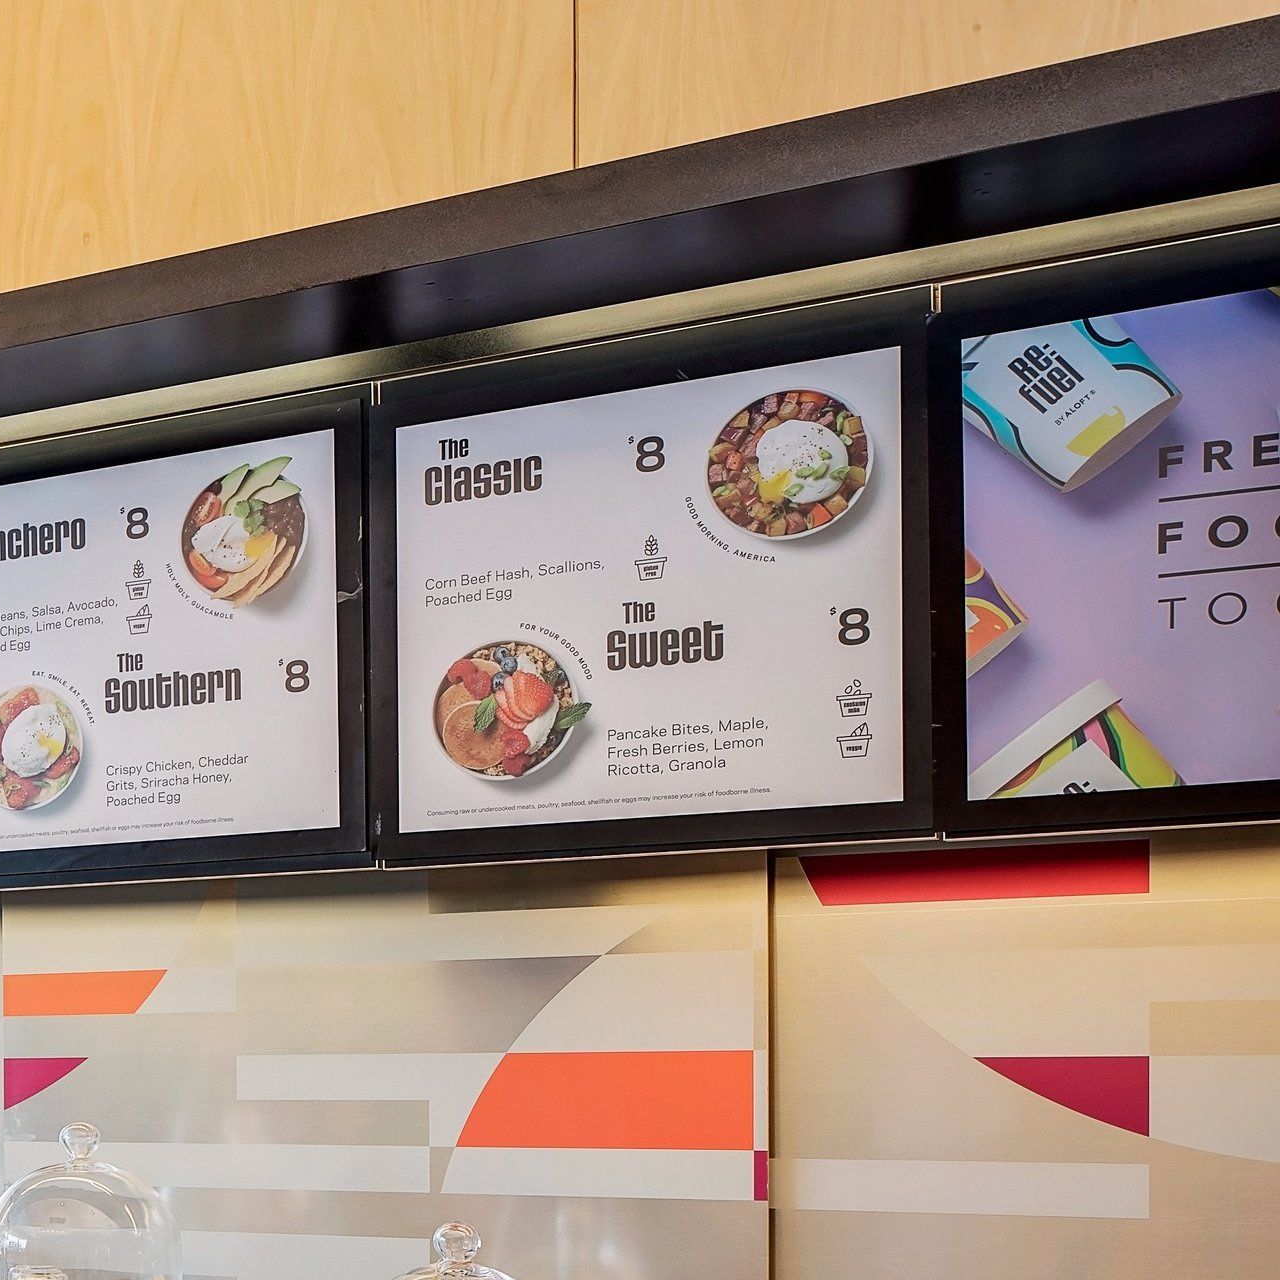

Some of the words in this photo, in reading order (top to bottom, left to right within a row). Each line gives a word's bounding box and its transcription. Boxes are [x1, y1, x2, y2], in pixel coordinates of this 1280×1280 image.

[1007, 343, 1057, 385] Re:
[1018, 354, 1085, 415] fuel
[439, 438, 469, 461] The
[424, 455, 543, 506] Classic
[685, 496, 699, 520] GOOD
[696, 521, 730, 553] MORNING,
[733, 549, 776, 563] AMERICA
[1157, 515, 1280, 555] FO
[425, 577, 457, 591] Corn
[461, 570, 492, 587] Beef
[495, 566, 534, 582] Hash,
[538, 559, 605, 577] Scallions,
[165, 563, 177, 582] HOLY
[191, 600, 234, 620] GUACAMOLE
[425, 589, 482, 608] Poached
[486, 587, 513, 600] Egg
[32, 605, 64, 617] Salsa,
[67, 597, 118, 613] Avocado,
[622, 601, 656, 625] The
[0, 624, 32, 637] Chips,
[36, 620, 62, 632] Lime
[64, 615, 104, 628] Crema,
[9, 640, 31, 651] Egg
[520, 623, 537, 631] FOR
[539, 627, 560, 640] YOUR
[560, 639, 580, 657] GOOD
[578, 657, 593, 680] MOOD
[606, 620, 724, 672] Sweet
[117, 653, 143, 673] The
[104, 667, 241, 714] Southern
[607, 725, 667, 741] Pancake
[672, 723, 714, 736] Bites,
[719, 717, 769, 732] Maple,
[607, 744, 648, 758] Fresh
[652, 741, 709, 755] Berries,
[714, 737, 764, 750] Lemon
[106, 765, 143, 776] Crispy
[145, 759, 195, 773] Chicken,
[198, 754, 249, 768] Cheddar
[607, 764, 664, 776] Ricotta,
[669, 756, 726, 771] Granola
[106, 780, 137, 792] Grits,
[141, 775, 189, 789] Sriracha
[192, 772, 232, 784] Honey,
[106, 793, 155, 807] Poached
[158, 791, 181, 805] Egg
[426, 809, 458, 817] Consuming
[478, 805, 516, 813] undercooked
[652, 793, 679, 801] increase
[715, 788, 748, 796] foodborne
